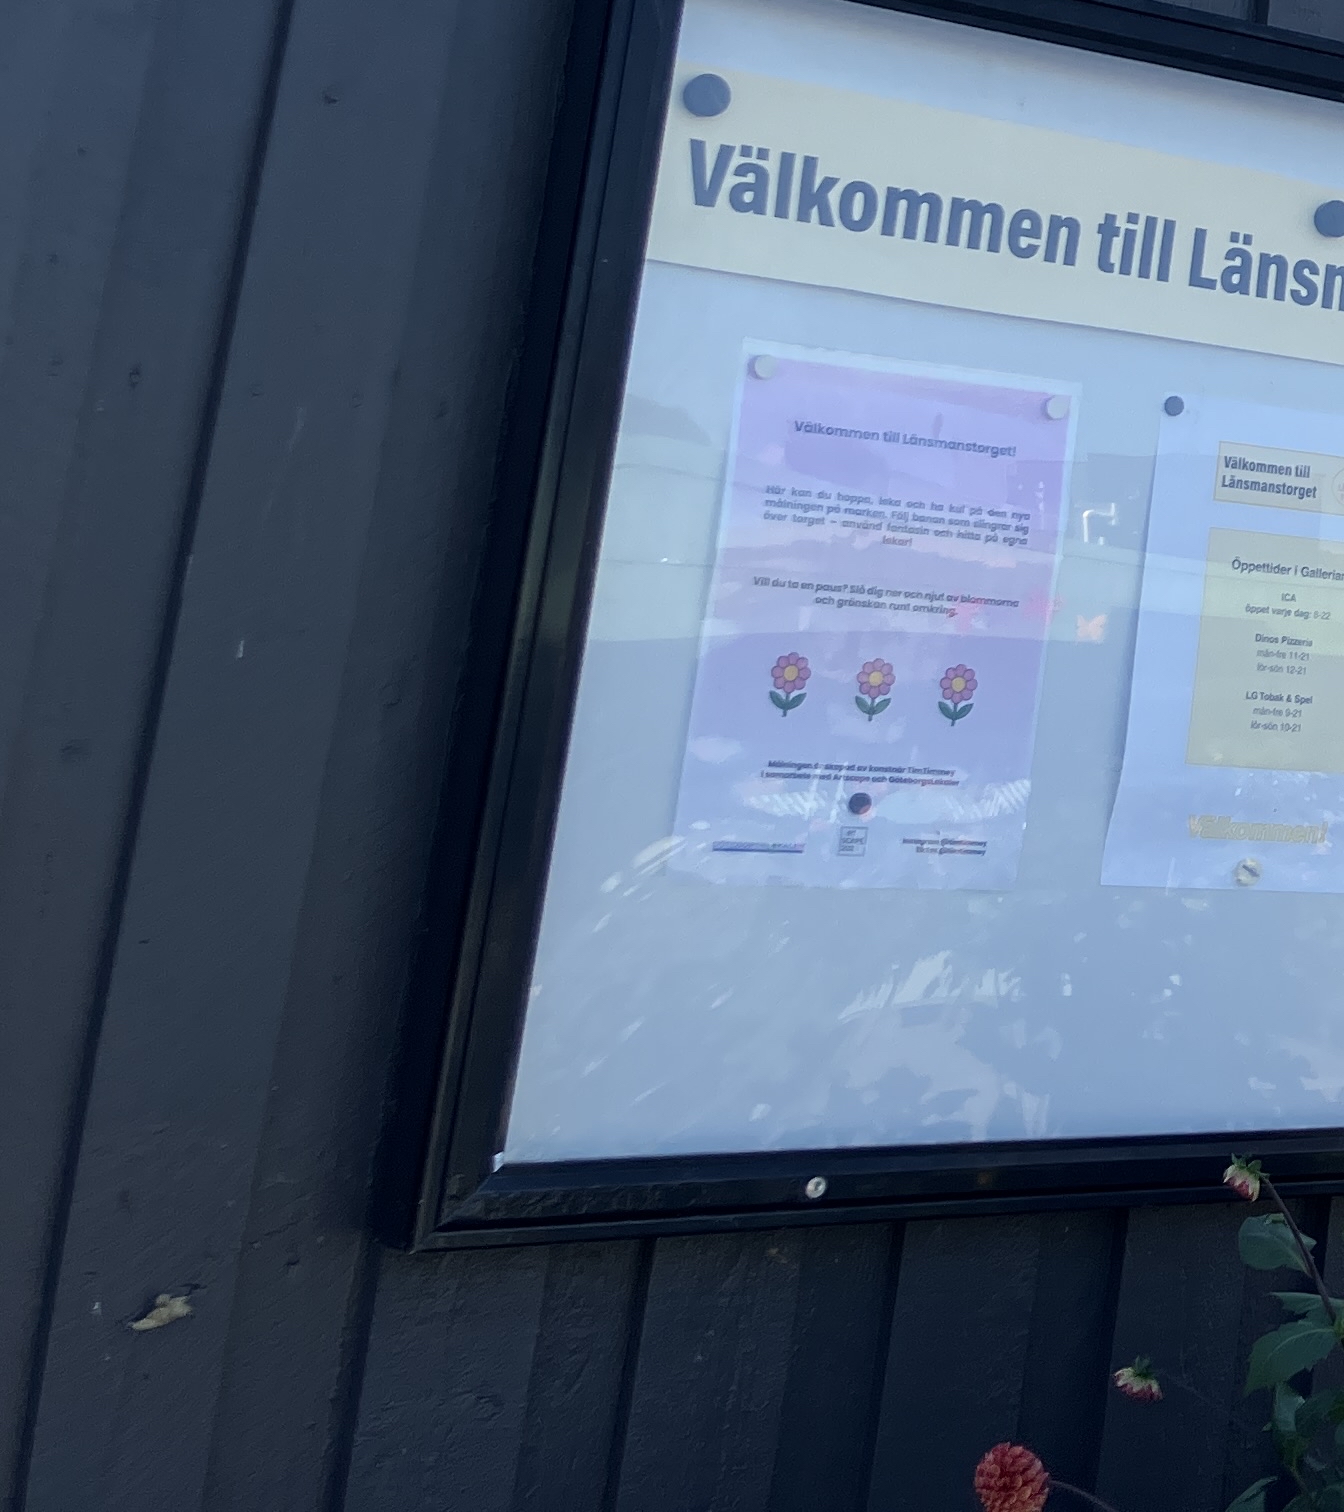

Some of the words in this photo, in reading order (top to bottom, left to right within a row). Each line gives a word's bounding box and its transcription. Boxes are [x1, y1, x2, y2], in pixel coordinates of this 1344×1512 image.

[689, 137, 1082, 267] Välkommen
[1096, 211, 1177, 283] till
[794, 420, 880, 441] Välkommen
[882, 430, 901, 444] till
[902, 433, 1017, 458] Länsmanstorget!
[1223, 455, 1293, 477] Välkommen
[1294, 464, 1311, 479] till
[791, 487, 812, 497] kan
[817, 490, 832, 500] du
[1221, 474, 1318, 499] Länsmanstorget
[1231, 556, 1292, 576] Öppettider
[1281, 592, 1297, 603] ICA
[1245, 603, 1270, 615] öppet
[1271, 607, 1293, 618] varje
[1289, 651, 1310, 661] 11-21
[1286, 665, 1306, 675] 12-21
[1245, 691, 1258, 700] LG
[1259, 691, 1284, 702] Tobak
[1286, 694, 1292, 703] &
[1294, 694, 1313, 705] Spel
